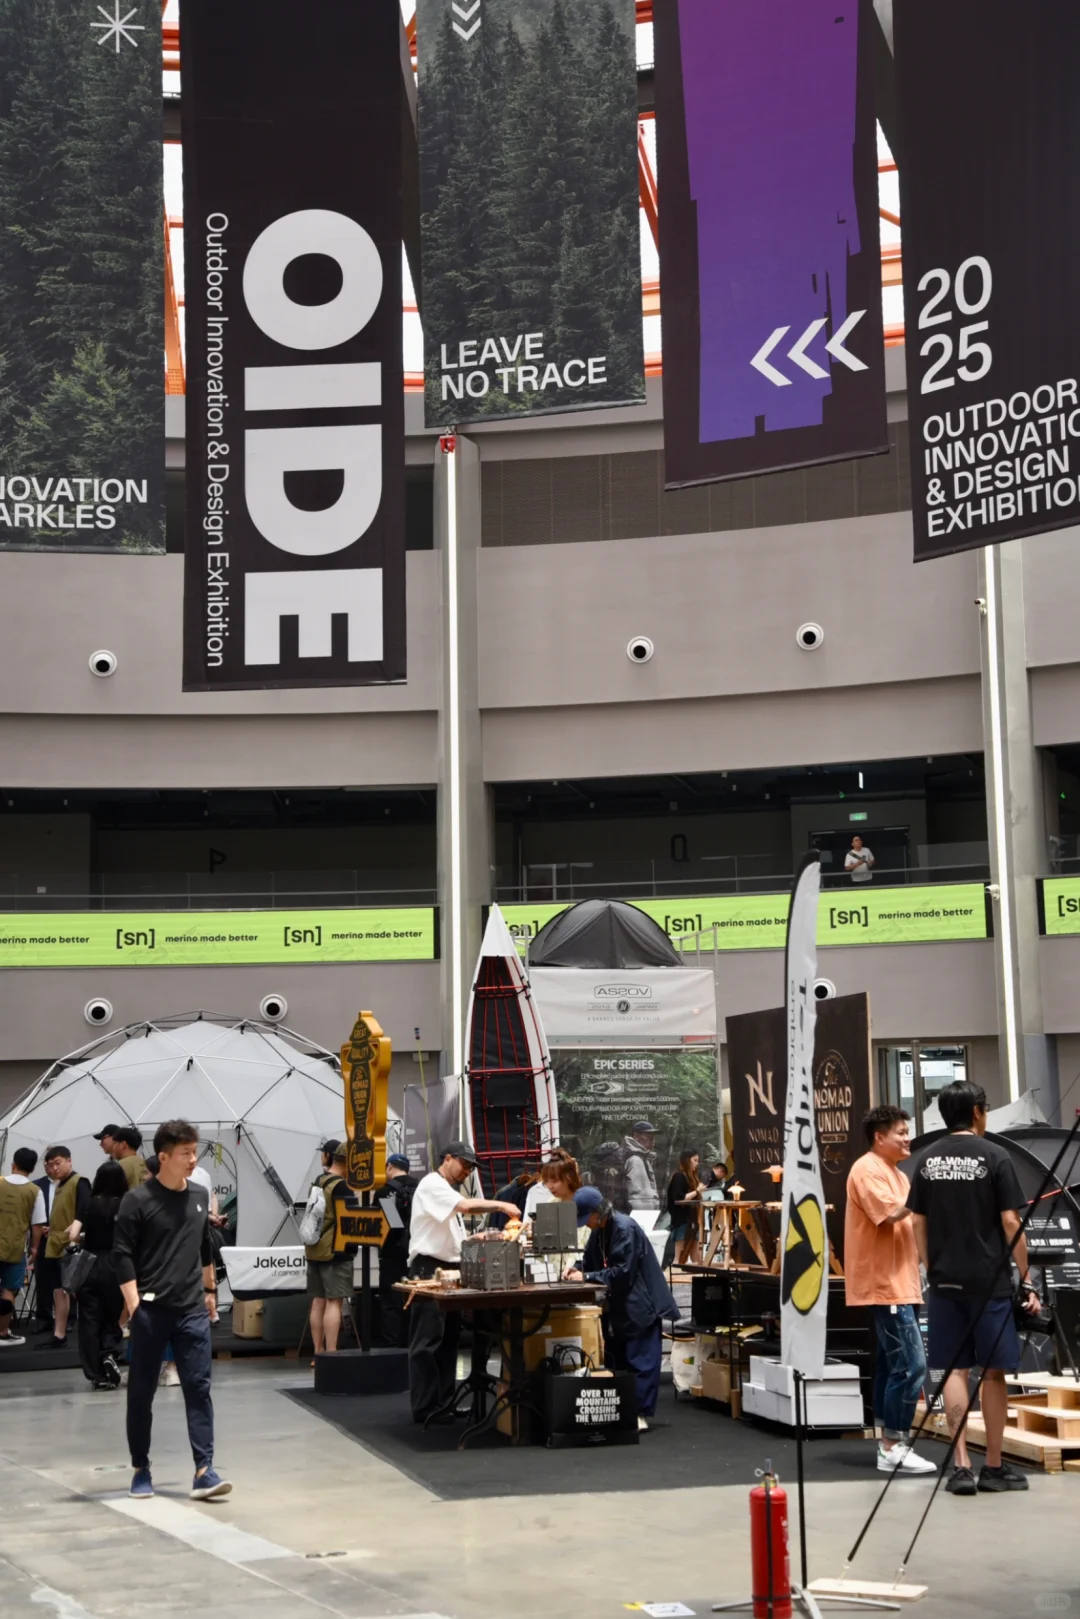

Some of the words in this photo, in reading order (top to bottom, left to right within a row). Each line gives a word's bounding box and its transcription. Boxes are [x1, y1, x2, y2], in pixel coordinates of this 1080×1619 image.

[206, 211, 230, 311] Outdoor
[917, 255, 993, 329] 20
[440, 332, 544, 371] LEAVE
[919, 320, 993, 394] 25
[206, 315, 230, 437] Innovation
[440, 369, 489, 402] NO
[493, 355, 608, 396] TRACE
[922, 378, 1078, 443] OUTDOOR
[241, 208, 384, 667] OIDE
[206, 440, 230, 460] &
[926, 477, 946, 506] &
[953, 445, 1070, 500] DESIGN
[202, 463, 230, 546] Design
[928, 474, 1080, 537] EXHIBITIO
[206, 551, 230, 668] Exhibition
[829, 905, 869, 928] [sn]
[878, 910, 911, 920] merino
[913, 909, 940, 919] made
[942, 907, 974, 917] better
[1058, 895, 1080, 917] [s
[712, 919, 745, 928] merino
[746, 918, 772, 927] made
[29, 935, 57, 944] made
[59, 935, 90, 944] better
[116, 928, 156, 949] [sn]
[165, 933, 197, 943] merino
[200, 932, 226, 942] made
[228, 932, 259, 942] better
[283, 925, 322, 946] [sn]
[331, 930, 363, 940] merino
[365, 929, 392, 939] made
[394, 929, 423, 939] better
[594, 1059, 617, 1070] EPIC
[619, 1059, 655, 1070] SERIES
[814, 1087, 853, 1109] NOMAD
[817, 1110, 850, 1132] UNION
[748, 1127, 779, 1143] NOMAD
[749, 1147, 781, 1163] UNION
[340, 1215, 383, 1238] WELCOME
[575, 1397, 621, 1406] MOUNTAINS
[580, 1389, 601, 1398] OVER
[603, 1388, 617, 1397] THE
[575, 1414, 589, 1423] THE
[591, 1413, 620, 1423] WATERS
[579, 1405, 616, 1415] CROSSING
